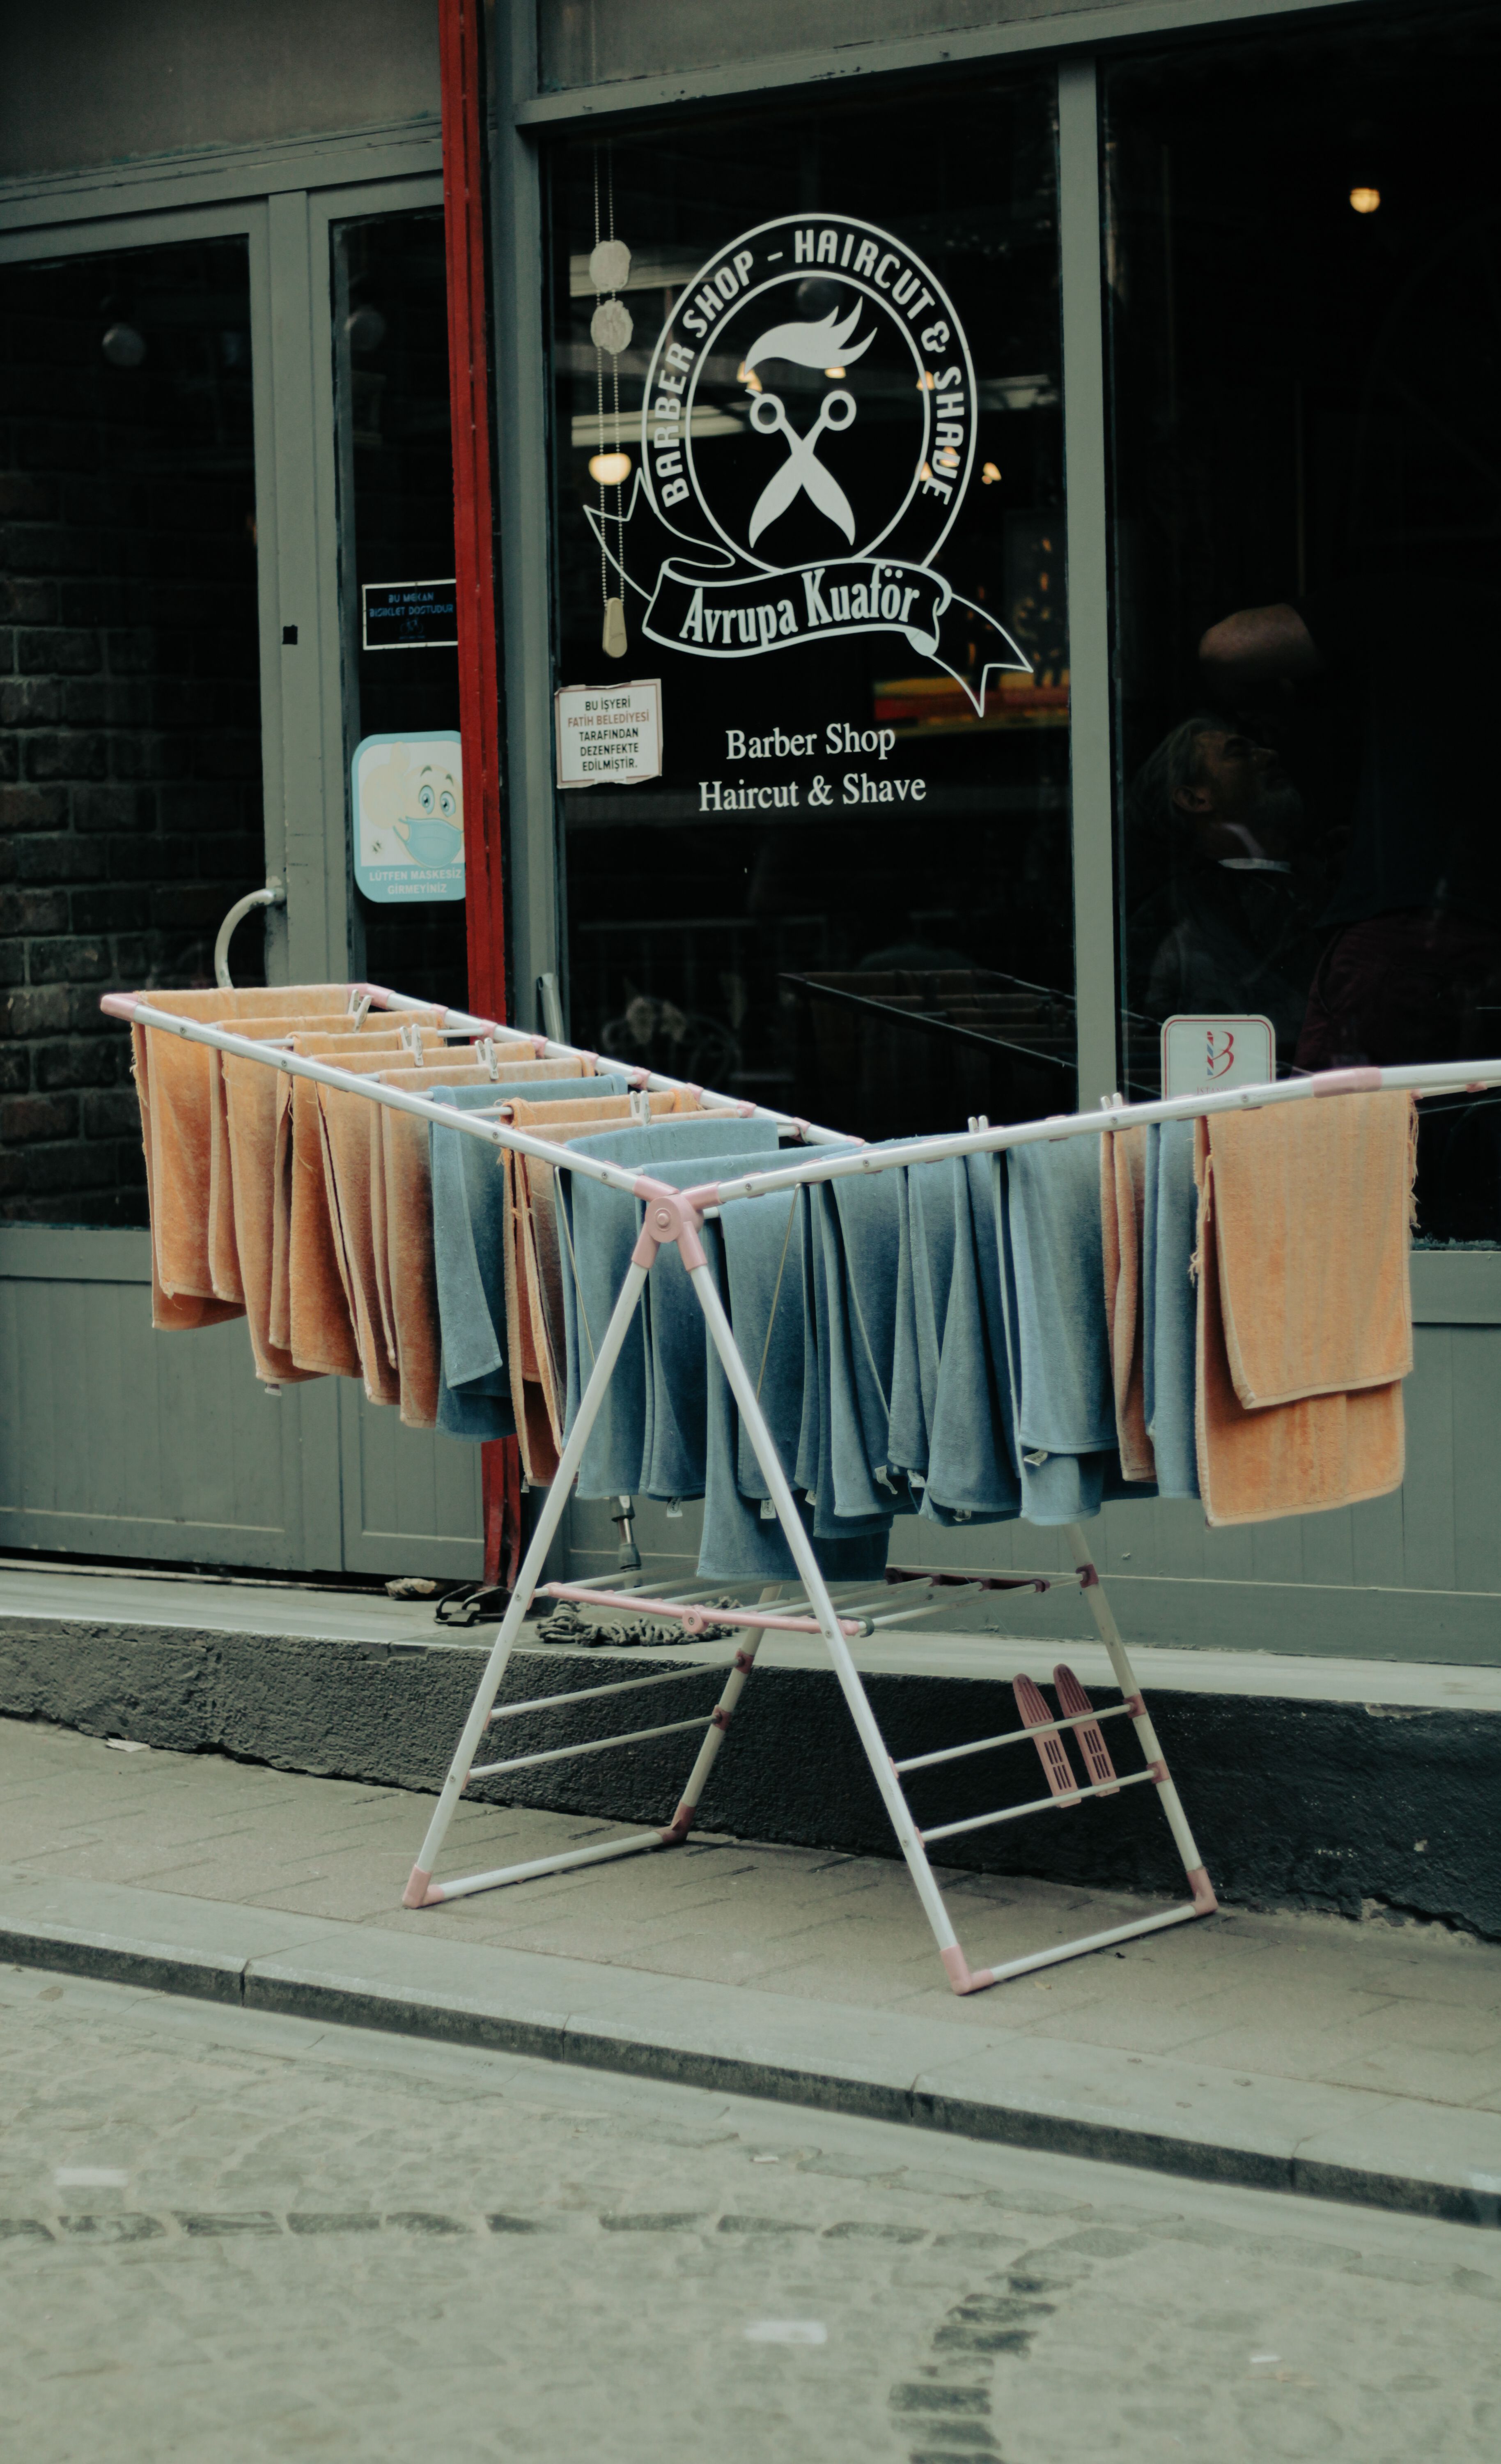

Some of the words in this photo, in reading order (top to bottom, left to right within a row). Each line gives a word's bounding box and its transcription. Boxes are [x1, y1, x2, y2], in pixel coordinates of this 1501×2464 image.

[795, 230, 935, 319] HAIRCUT
[683, 251, 753, 338] SHOP
[921, 321, 950, 352] &
[654, 343, 695, 507] BARBER
[922, 366, 964, 505] SHAVE
[388, 594, 400, 603] BU
[679, 587, 799, 646] Avrupa
[801, 565, 920, 627] Kuaför
[409, 604, 454, 615] DOSTUDUR
[585, 700, 598, 711] BU
[601, 696, 631, 712] İŞYERİ
[568, 714, 594, 728] FATİH
[597, 709, 649, 726] BELEDİYESİ
[579, 728, 639, 742] TARAFINDAN
[725, 727, 817, 759] Barber
[826, 723, 895, 760] Shop
[580, 742, 639, 756] DEZENFEKTE
[582, 756, 638, 772] EDİLMİŞTİR.
[699, 779, 799, 811] Haircut
[808, 775, 833, 806] &
[842, 773, 926, 804] Shave
[369, 870, 408, 882] LÜTFEN
[411, 867, 462, 880] MASKESİZ
[388, 883, 448, 894] GİRMEYİNİZ
